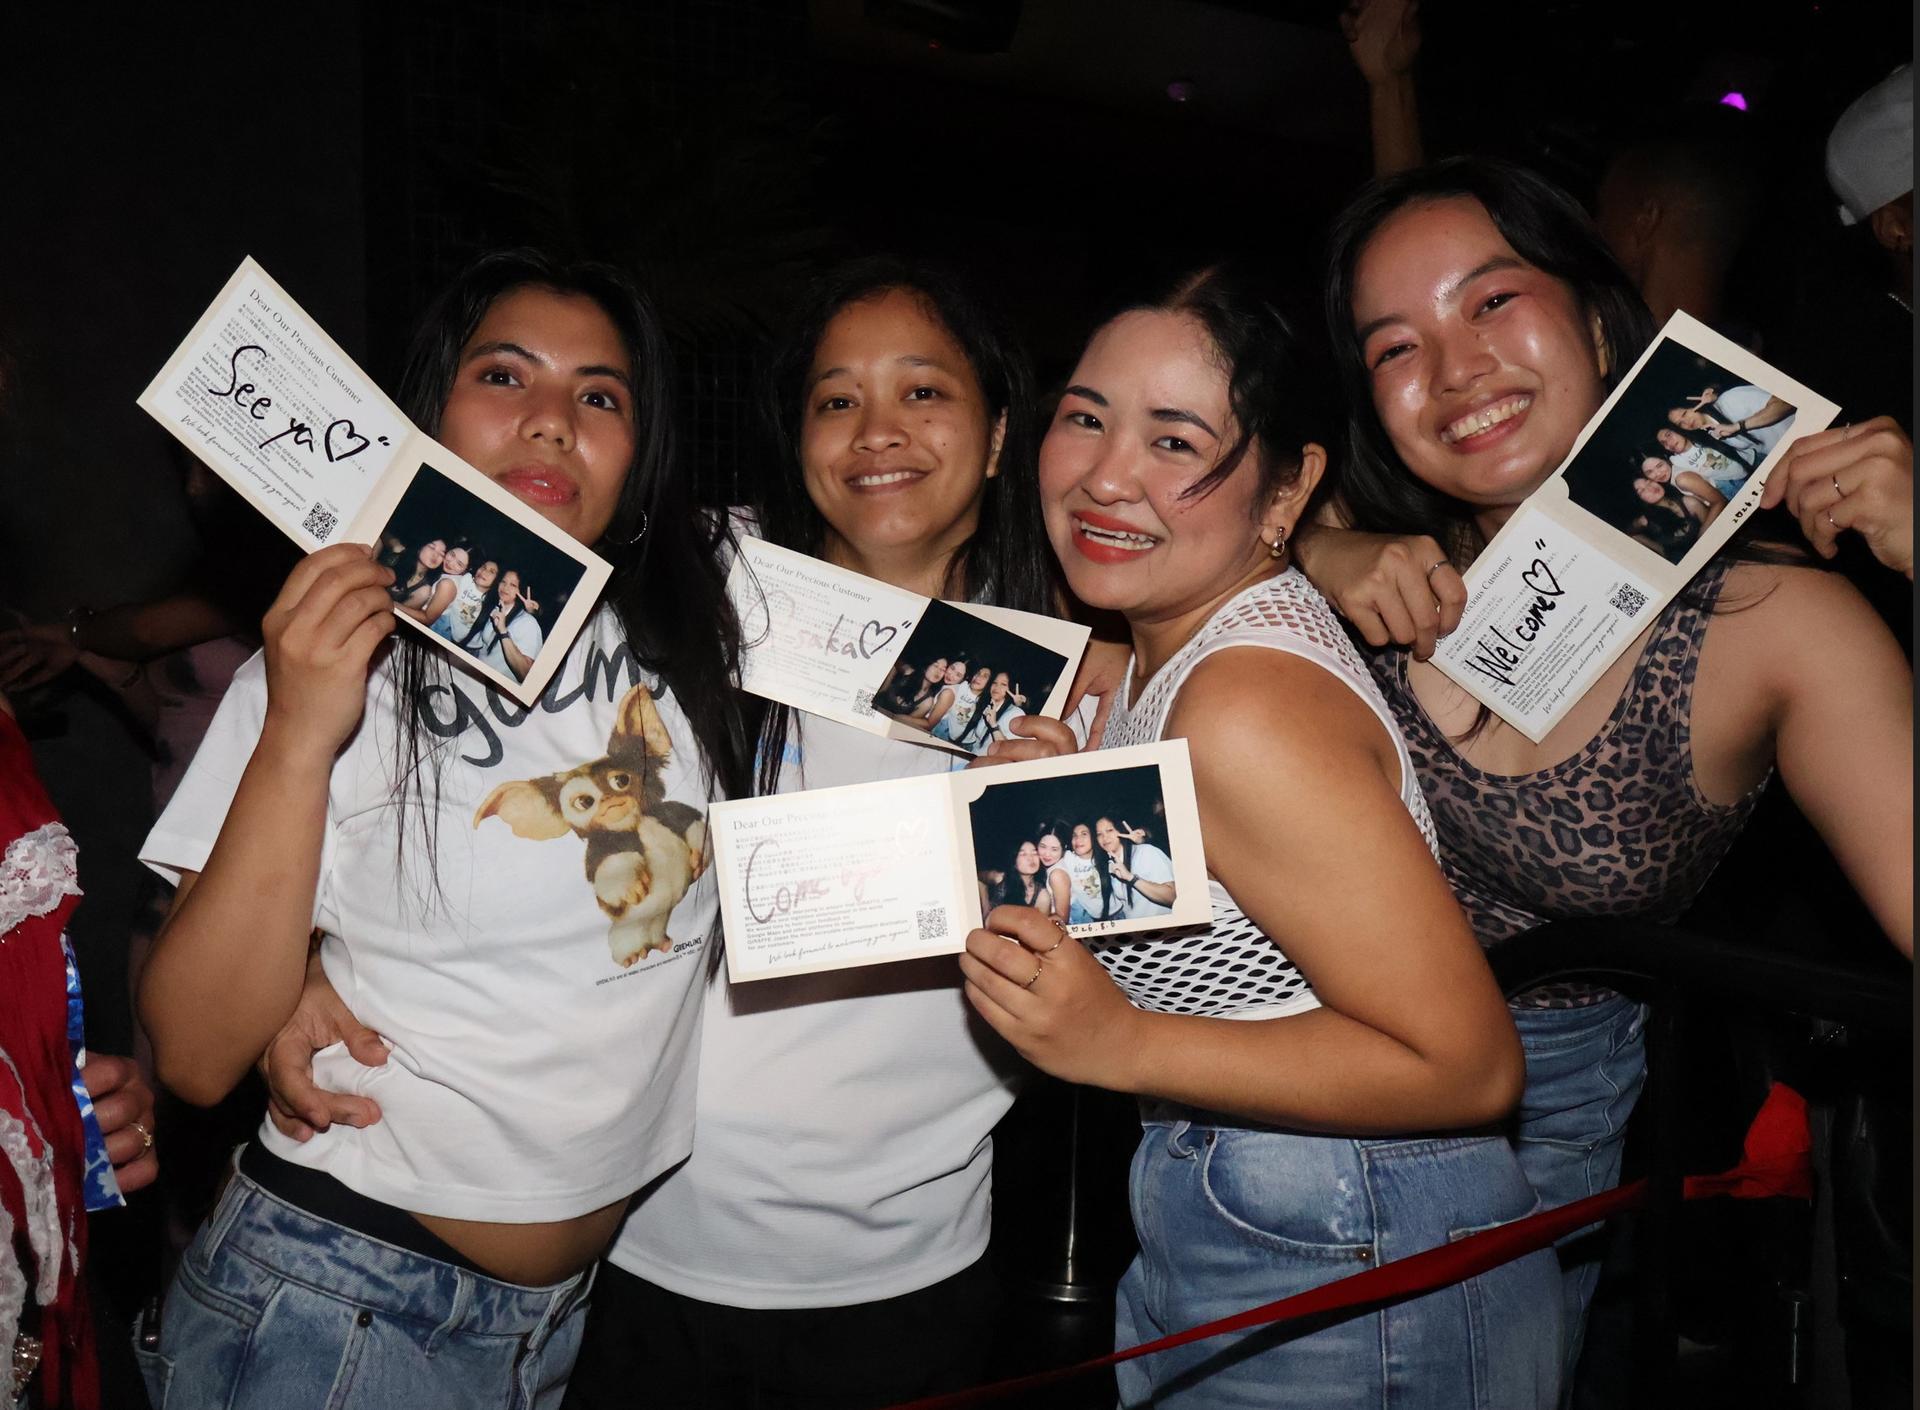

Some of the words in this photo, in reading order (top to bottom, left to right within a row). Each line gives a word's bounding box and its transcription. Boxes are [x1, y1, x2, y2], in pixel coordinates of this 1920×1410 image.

[249, 287, 272, 313] Dear
[271, 310, 292, 333] Our
[290, 329, 326, 368] Precious
[324, 364, 363, 406] Customer
[208, 345, 272, 420] See
[753, 555, 775, 570] Dear
[777, 562, 795, 577] Our
[796, 569, 831, 588] Precious
[832, 583, 873, 603] Customer
[1480, 553, 1513, 592] Customer
[1465, 594, 1557, 687] Welcome
[733, 817, 758, 830] Dear
[761, 814, 782, 827] Our
